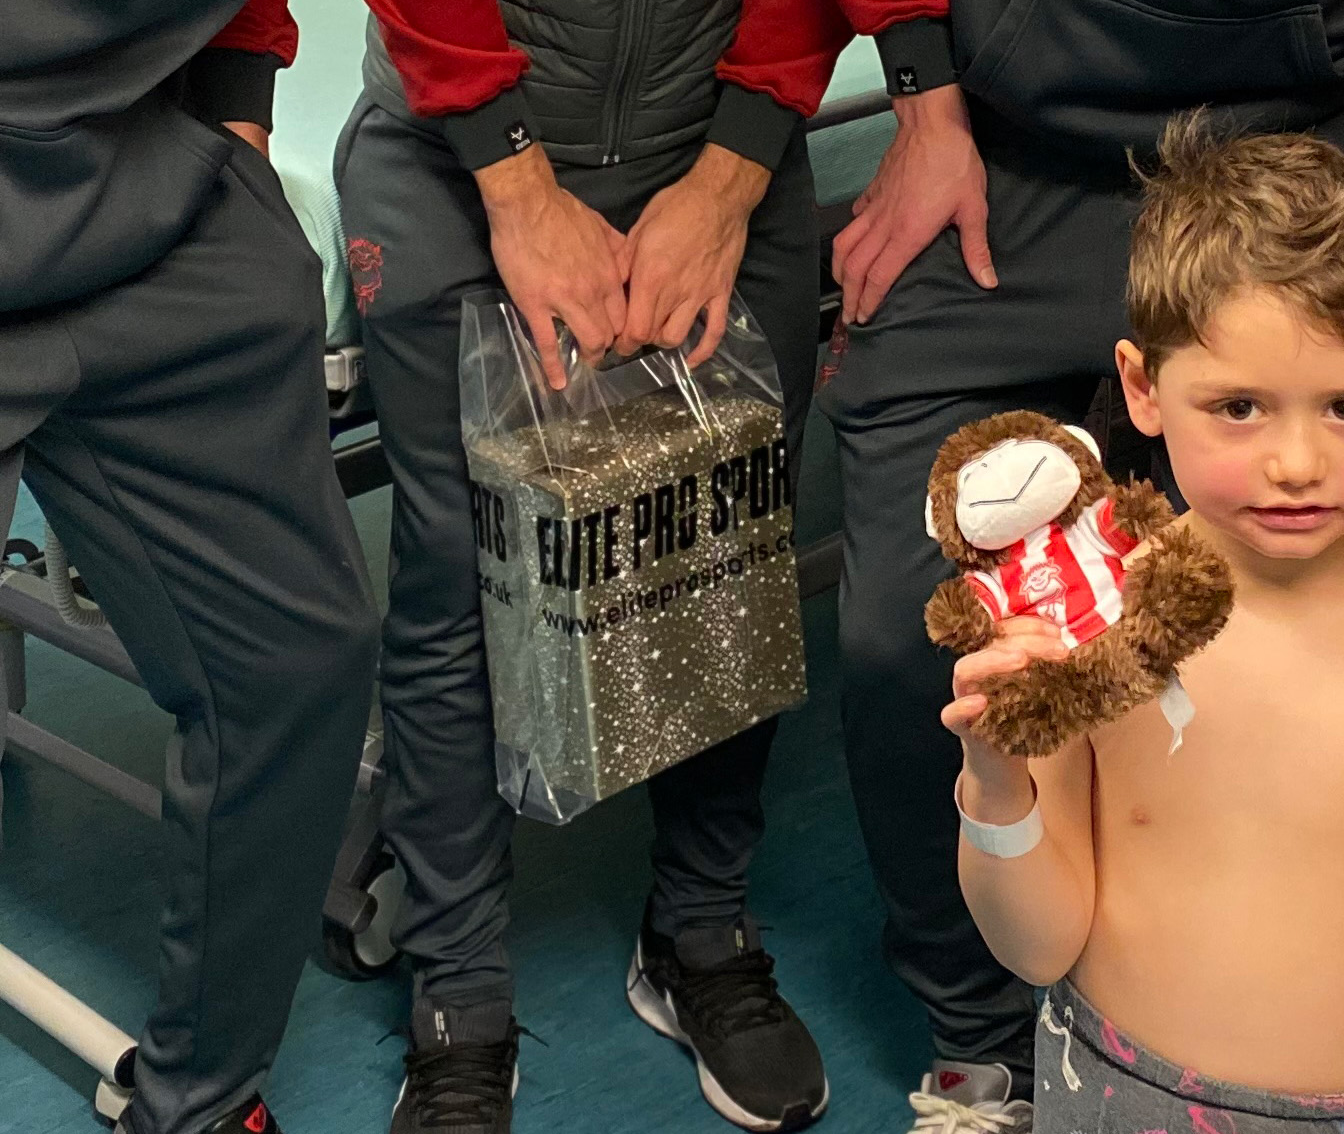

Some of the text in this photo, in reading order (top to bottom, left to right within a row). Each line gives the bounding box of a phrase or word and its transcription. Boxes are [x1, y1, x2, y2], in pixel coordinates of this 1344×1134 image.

[537, 438, 791, 592] ELITE PRO SPOR
